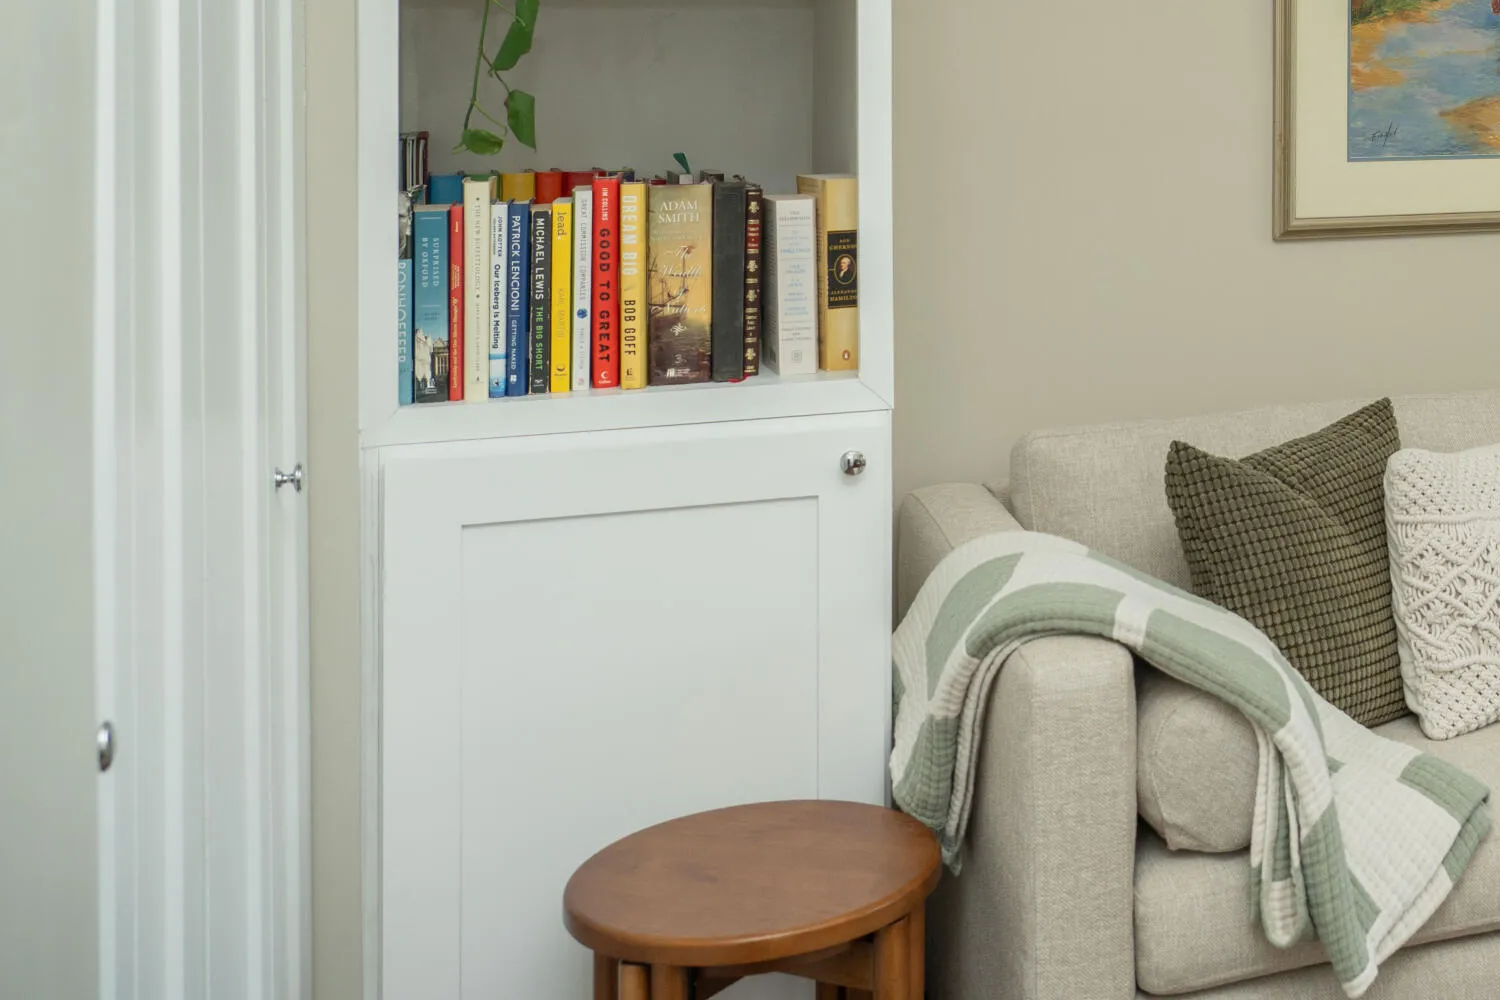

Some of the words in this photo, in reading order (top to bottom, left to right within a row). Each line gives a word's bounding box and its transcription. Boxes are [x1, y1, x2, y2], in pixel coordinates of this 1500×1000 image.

[579, 198, 588, 219] GREAT
[622, 195, 638, 245] DREAM
[659, 213, 699, 223] SMITH
[661, 200, 697, 211] ADAM
[421, 237, 429, 247] BY
[511, 215, 521, 257] PATRICK
[535, 218, 545, 263] MICHAEL
[579, 222, 588, 261] COMMISSION
[599, 228, 611, 272] GOOD
[421, 251, 429, 288] OXFORD
[432, 237, 440, 287] SURPRISED
[622, 251, 638, 276] BIG
[491, 280, 500, 309] Iceberg
[511, 260, 520, 310] LENCIONI
[535, 267, 544, 300] LEWIS
[579, 265, 587, 301] COMPANIES
[599, 280, 610, 301] TO
[535, 306, 543, 321] THE
[624, 299, 636, 322] BOB
[491, 320, 499, 349] Melting
[535, 325, 543, 339] BIG
[599, 310, 610, 363] GREAT
[624, 327, 636, 356] GOFF
[535, 342, 543, 370] SHORT
